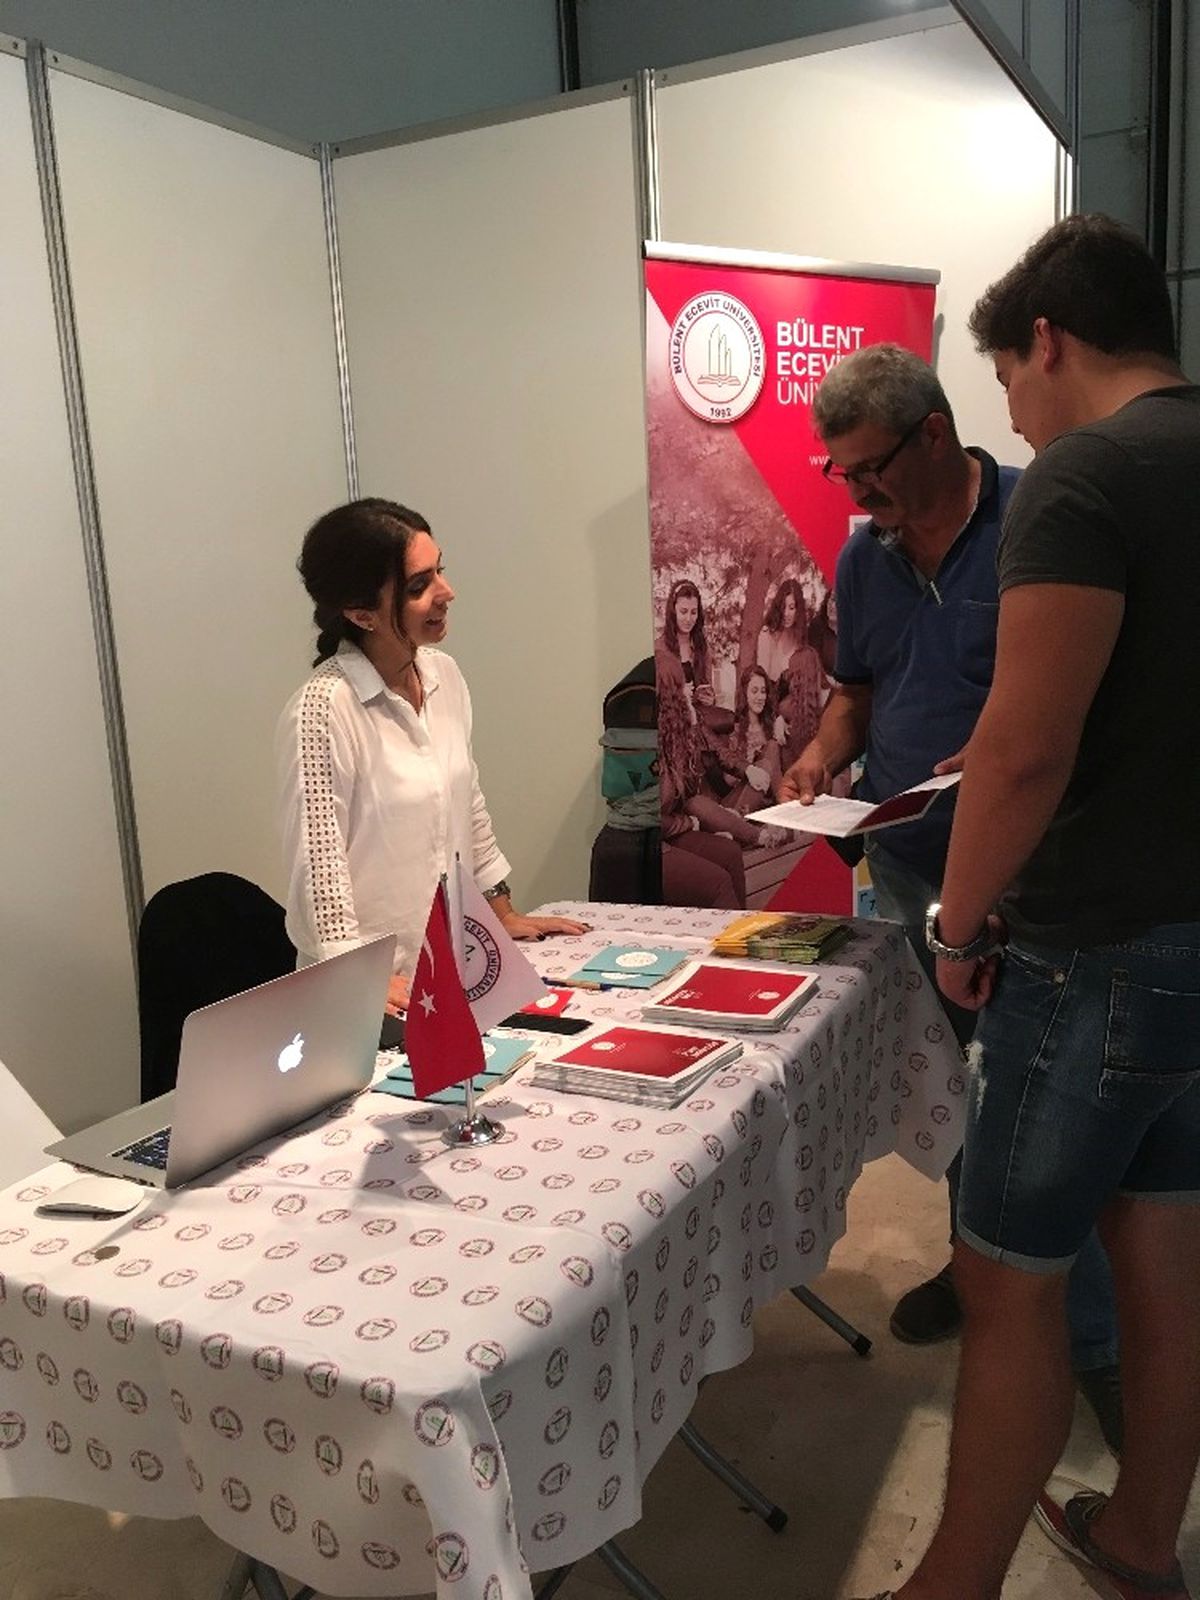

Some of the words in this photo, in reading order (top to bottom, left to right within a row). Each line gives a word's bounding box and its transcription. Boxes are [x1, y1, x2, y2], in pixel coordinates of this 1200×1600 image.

[777, 318, 865, 350] BÜLENT
[777, 350, 847, 377] ECEVİ
[777, 377, 820, 406] ÜNİ
